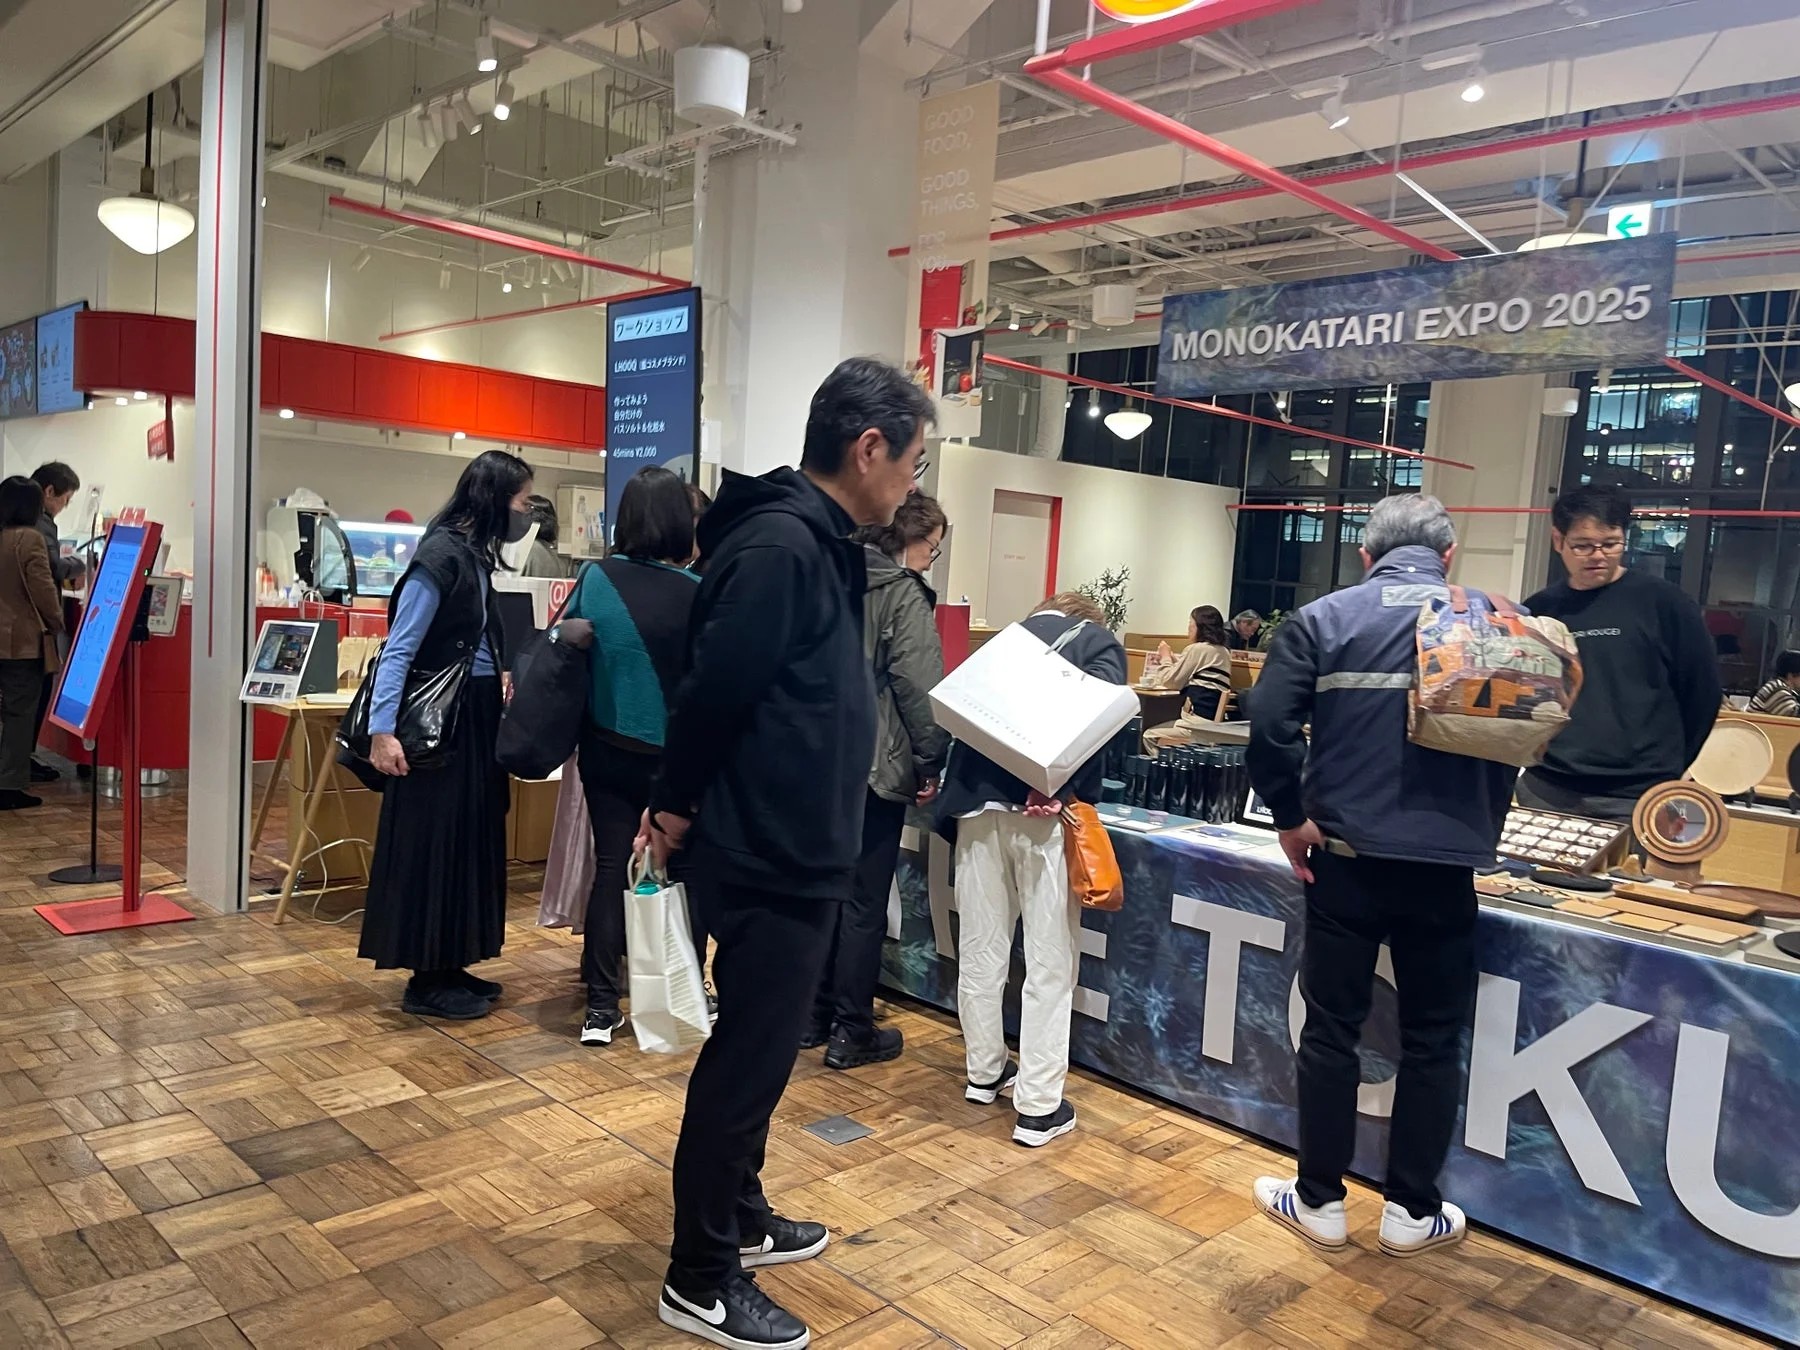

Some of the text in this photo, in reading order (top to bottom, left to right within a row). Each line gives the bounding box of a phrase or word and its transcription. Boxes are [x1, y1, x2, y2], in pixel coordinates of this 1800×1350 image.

[925, 105, 975, 132] GOOD
[921, 168, 970, 195] GOOD
[616, 311, 685, 337] ワークショップ
[1171, 284, 1652, 361] MONOKATARI EXPO 2025
[613, 408, 643, 421] 自分だけの
